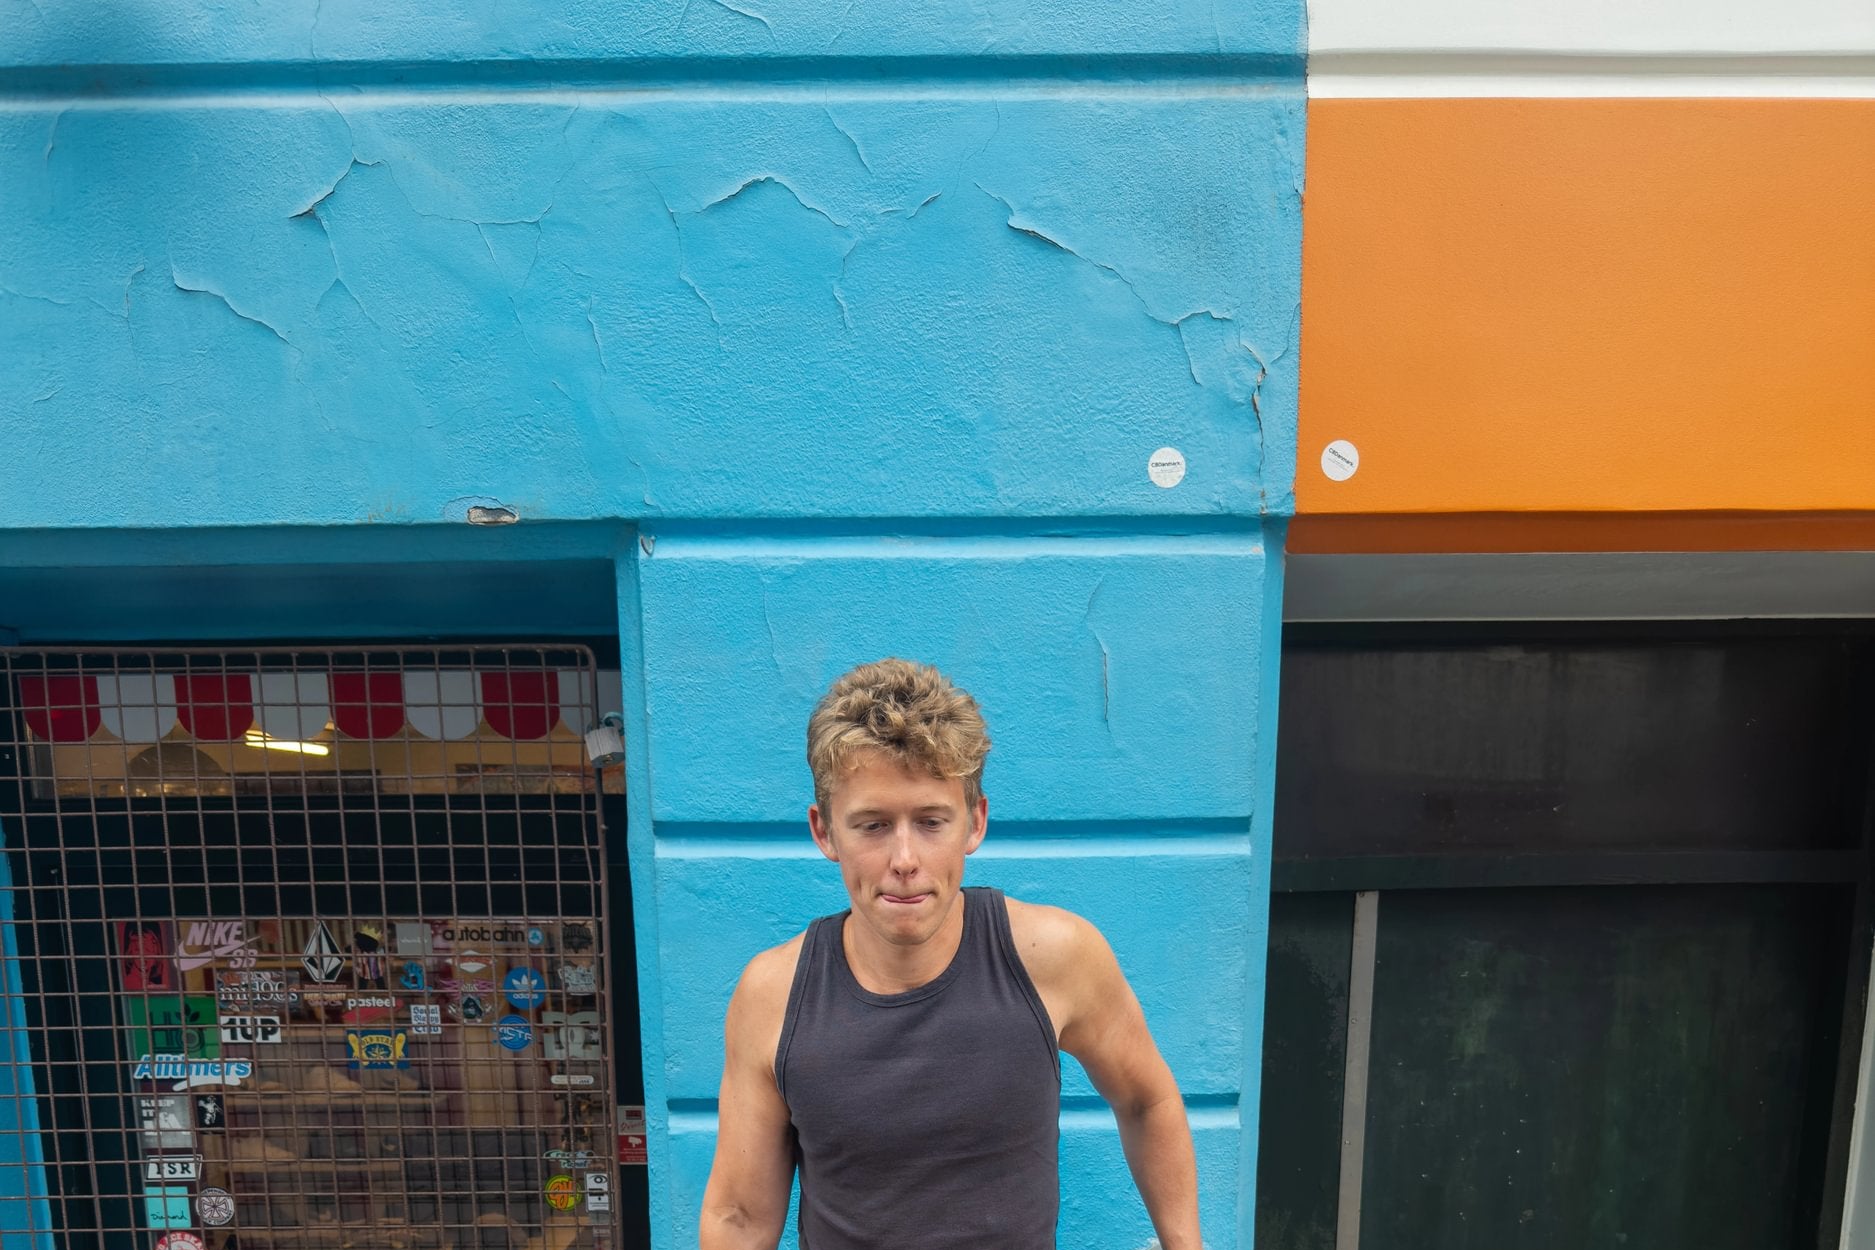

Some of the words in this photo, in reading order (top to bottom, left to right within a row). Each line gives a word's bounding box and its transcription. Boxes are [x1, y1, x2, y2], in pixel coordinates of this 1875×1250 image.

[186, 922, 243, 945] NIKE
[443, 927, 525, 942] autobahn
[222, 1018, 279, 1041] 1UP
[136, 1055, 250, 1077] Alltimers
